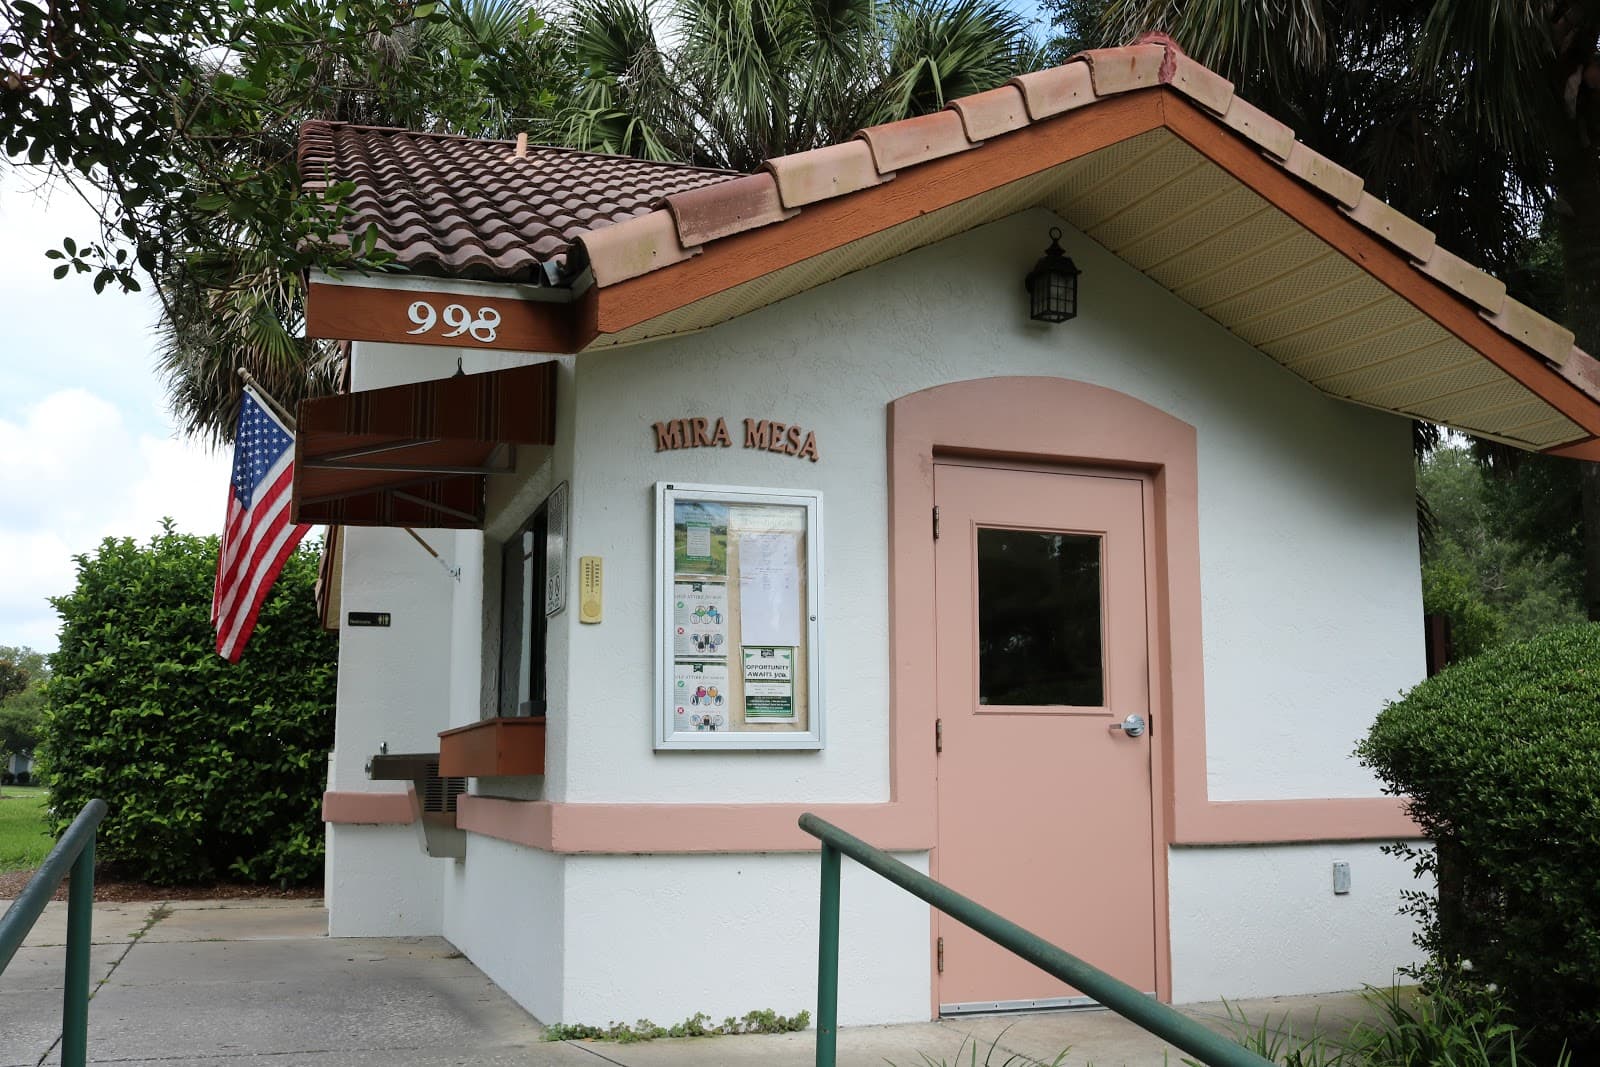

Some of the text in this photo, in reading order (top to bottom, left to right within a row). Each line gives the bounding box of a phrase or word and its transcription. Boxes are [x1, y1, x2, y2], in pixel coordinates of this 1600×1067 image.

[406, 301, 501, 342] 998
[652, 416, 819, 462] MIRA MESA
